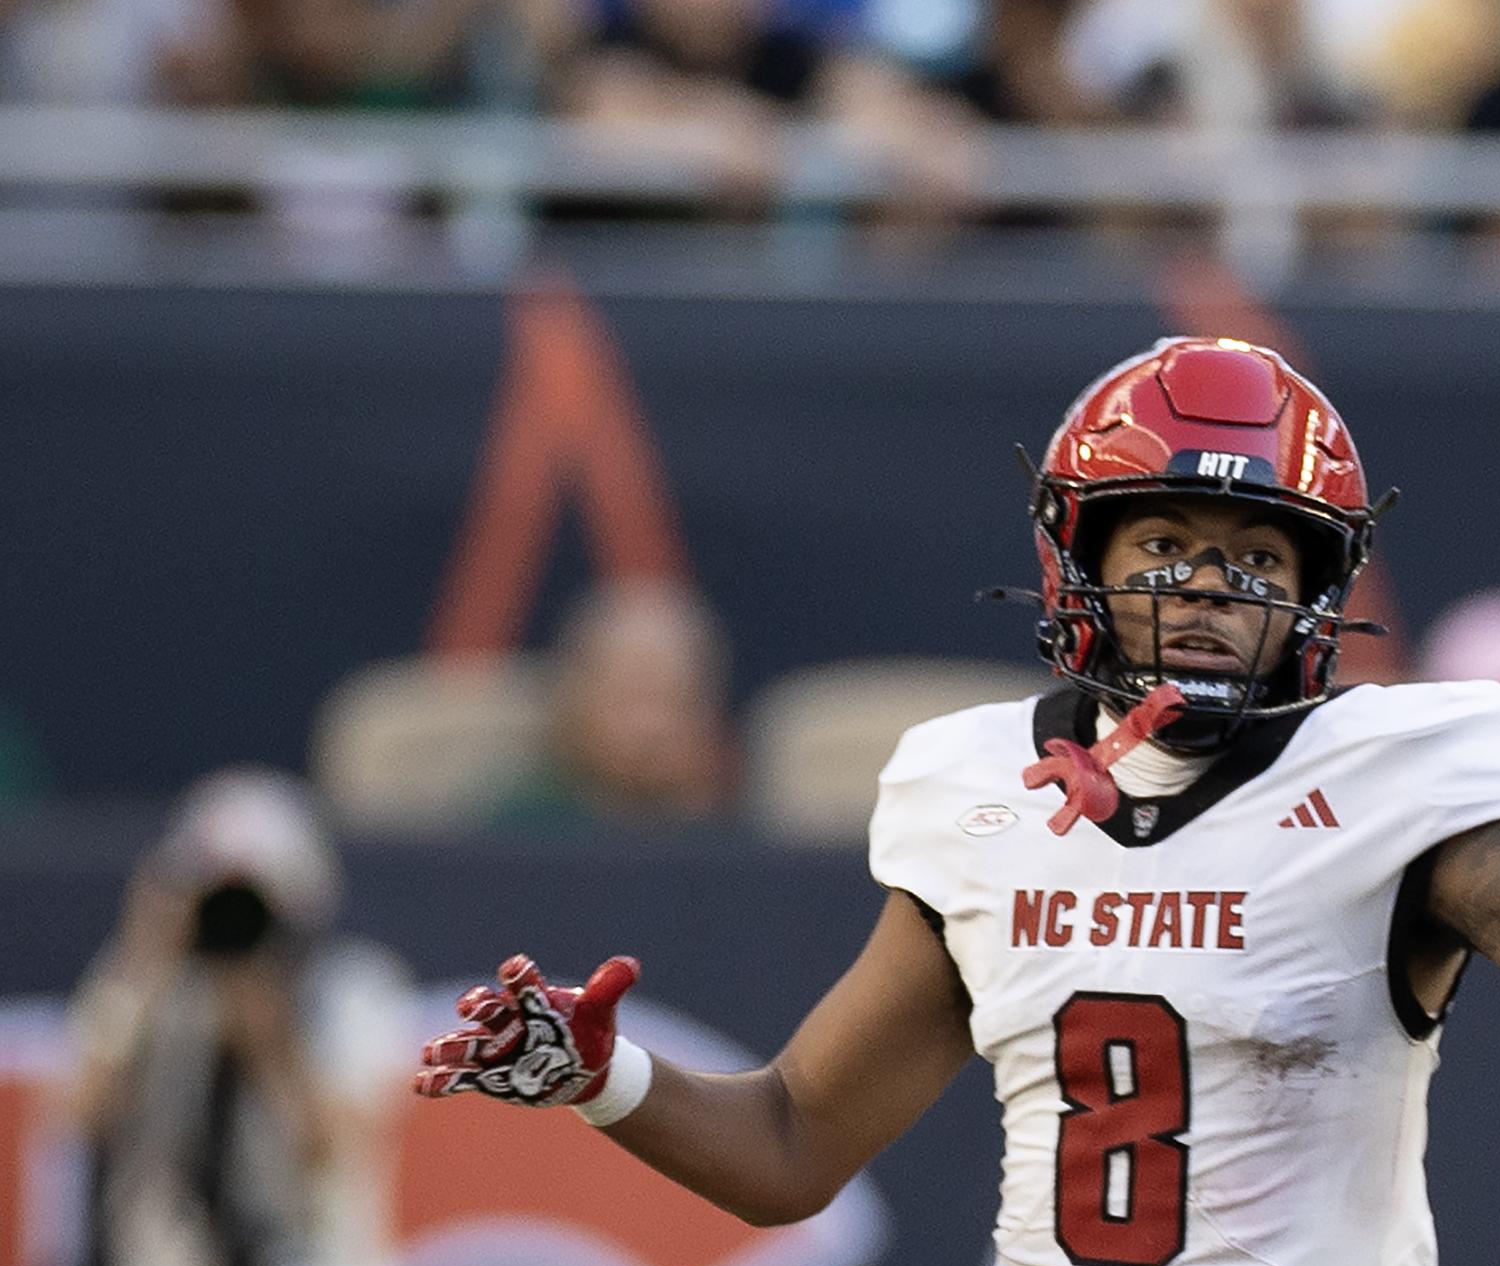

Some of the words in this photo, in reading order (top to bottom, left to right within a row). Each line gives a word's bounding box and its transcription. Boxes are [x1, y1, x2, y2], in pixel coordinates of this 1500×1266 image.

[1197, 451, 1250, 480] HTT
[1010, 890, 1077, 950] NC
[1088, 890, 1249, 951] STATE
